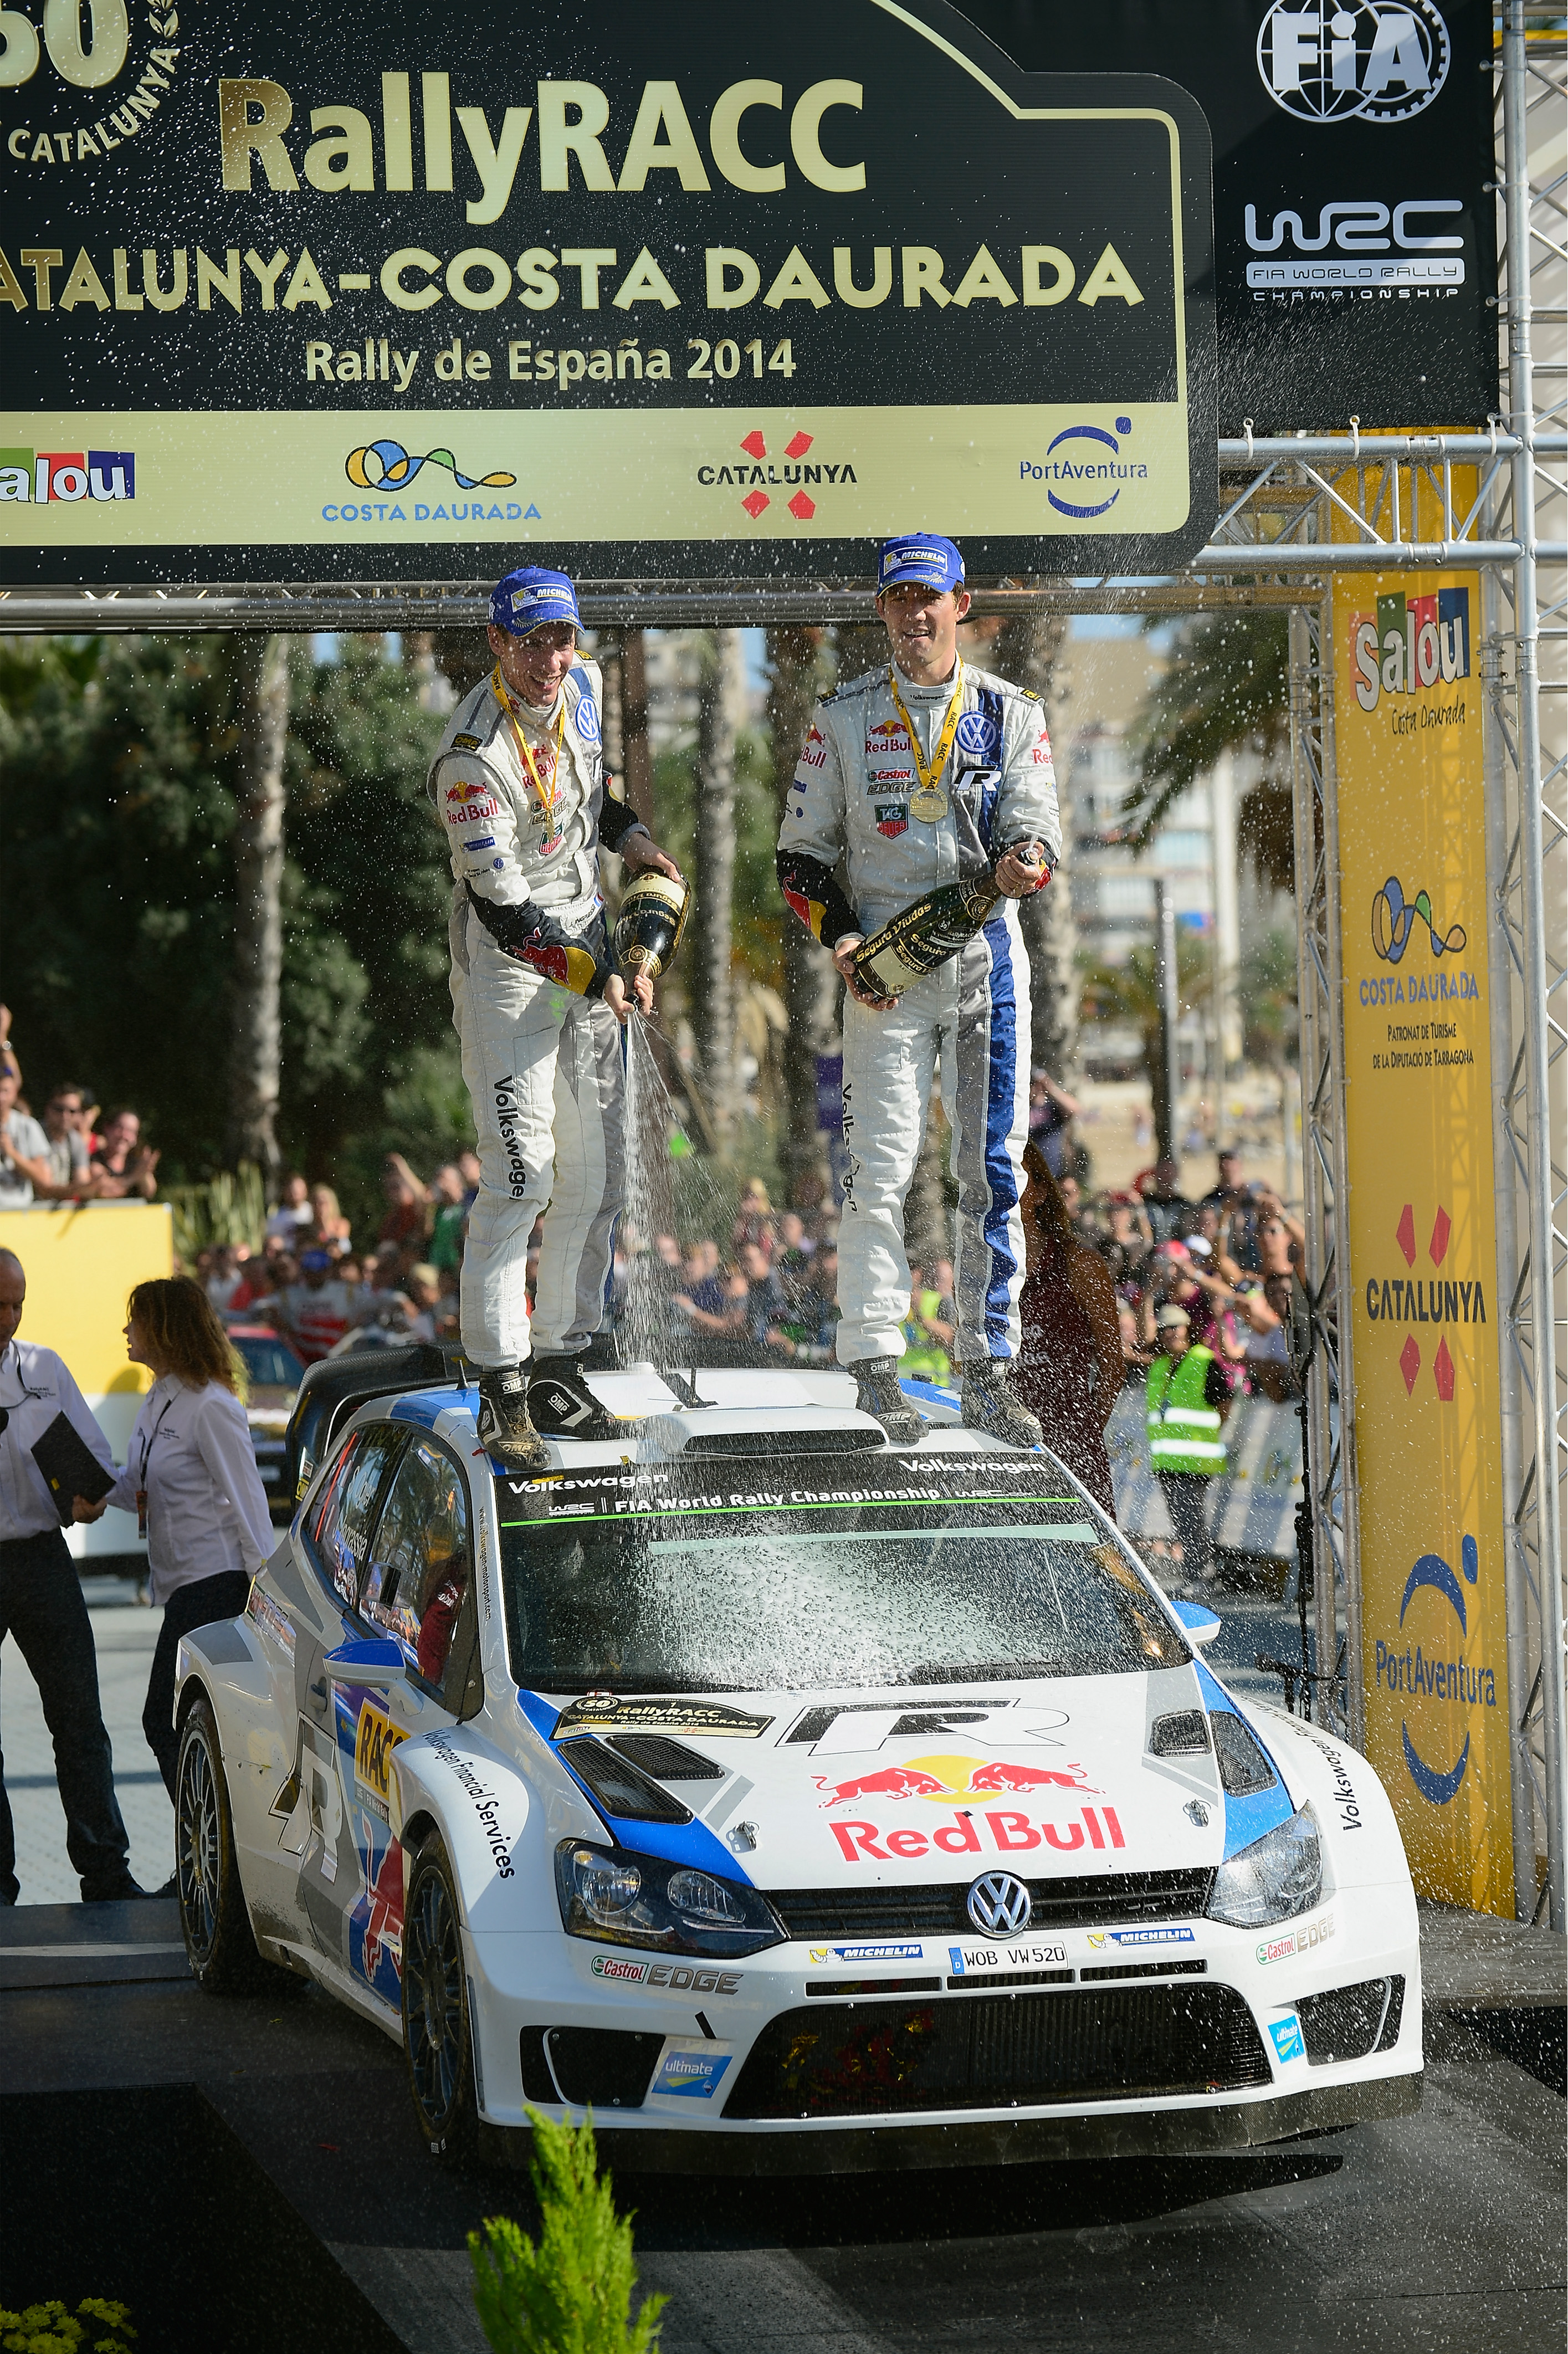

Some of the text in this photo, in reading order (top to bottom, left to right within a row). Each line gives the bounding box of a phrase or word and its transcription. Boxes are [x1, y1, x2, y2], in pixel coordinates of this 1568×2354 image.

[8, 48, 181, 163] CATALUNYA
[219, 71, 866, 225] RallyRACC
[1245, 200, 1464, 251] WRC
[705, 242, 1145, 309] DAURADA
[1254, 266, 1457, 279] FIA WORLD RALLY
[1253, 288, 1458, 301] CHAMPIONSHIP
[307, 336, 797, 392] Rally de España 2014
[697, 464, 857, 485] CATALUNYA
[1019, 460, 1149, 480] PortAventura
[322, 502, 542, 522] COSTA DAURADA
[901, 551, 945, 564] MICHELIN
[947, 711, 957, 730] RACC
[1392, 695, 1465, 735] Costa Daurada
[865, 740, 888, 754] Red
[937, 742, 949, 761] RACC
[917, 751, 927, 770] RACC
[877, 769, 911, 781] Castrol
[867, 782, 917, 795] EDGE
[447, 798, 499, 826] Red Bull
[640, 909, 676, 926] Segura
[856, 903, 932, 963] Segura Viudas
[910, 933, 946, 956] Segura
[896, 944, 921, 973] Segura
[1359, 971, 1479, 1006] COSTA DAURADA
[1421, 1025, 1429, 1040] DE
[1373, 1055, 1381, 1069] DE
[1382, 1053, 1390, 1068] LA
[1425, 1051, 1433, 1067] DE
[494, 1074, 524, 1200] Volkswage
[1366, 1278, 1487, 1323] CATALUNYA
[870, 1363, 890, 1372] OMP
[502, 1380, 521, 1391] OMP
[550, 1394, 568, 1413] OMP
[898, 1459, 1048, 1475] Volkswagen
[509, 1474, 669, 1495] Volkswagen
[549, 1502, 595, 1512] WRC
[615, 1500, 653, 1513] FIA
[657, 1495, 722, 1509] World
[731, 1492, 785, 1506] Rally
[791, 1487, 941, 1504] Championship
[1376, 1640, 1497, 1707] PortAventura
[583, 1700, 611, 1708] 50
[616, 1706, 722, 1718] RallyRACC
[686, 1718, 759, 1727] DAURADA
[1310, 1738, 1362, 1831] Volkswagen
[422, 1729, 515, 1880] Volkswagen Financial Services
[829, 1806, 1126, 1862] Red Bull
[1120, 1927, 1192, 1944] MICHELIN
[1267, 1915, 1336, 1961] Castrol EDGE
[843, 1944, 921, 1958] MICHELIN
[964, 1951, 998, 1967] WOB
[603, 1959, 744, 1995] Castrol EDGE
[665, 2059, 713, 2075] ultimate
